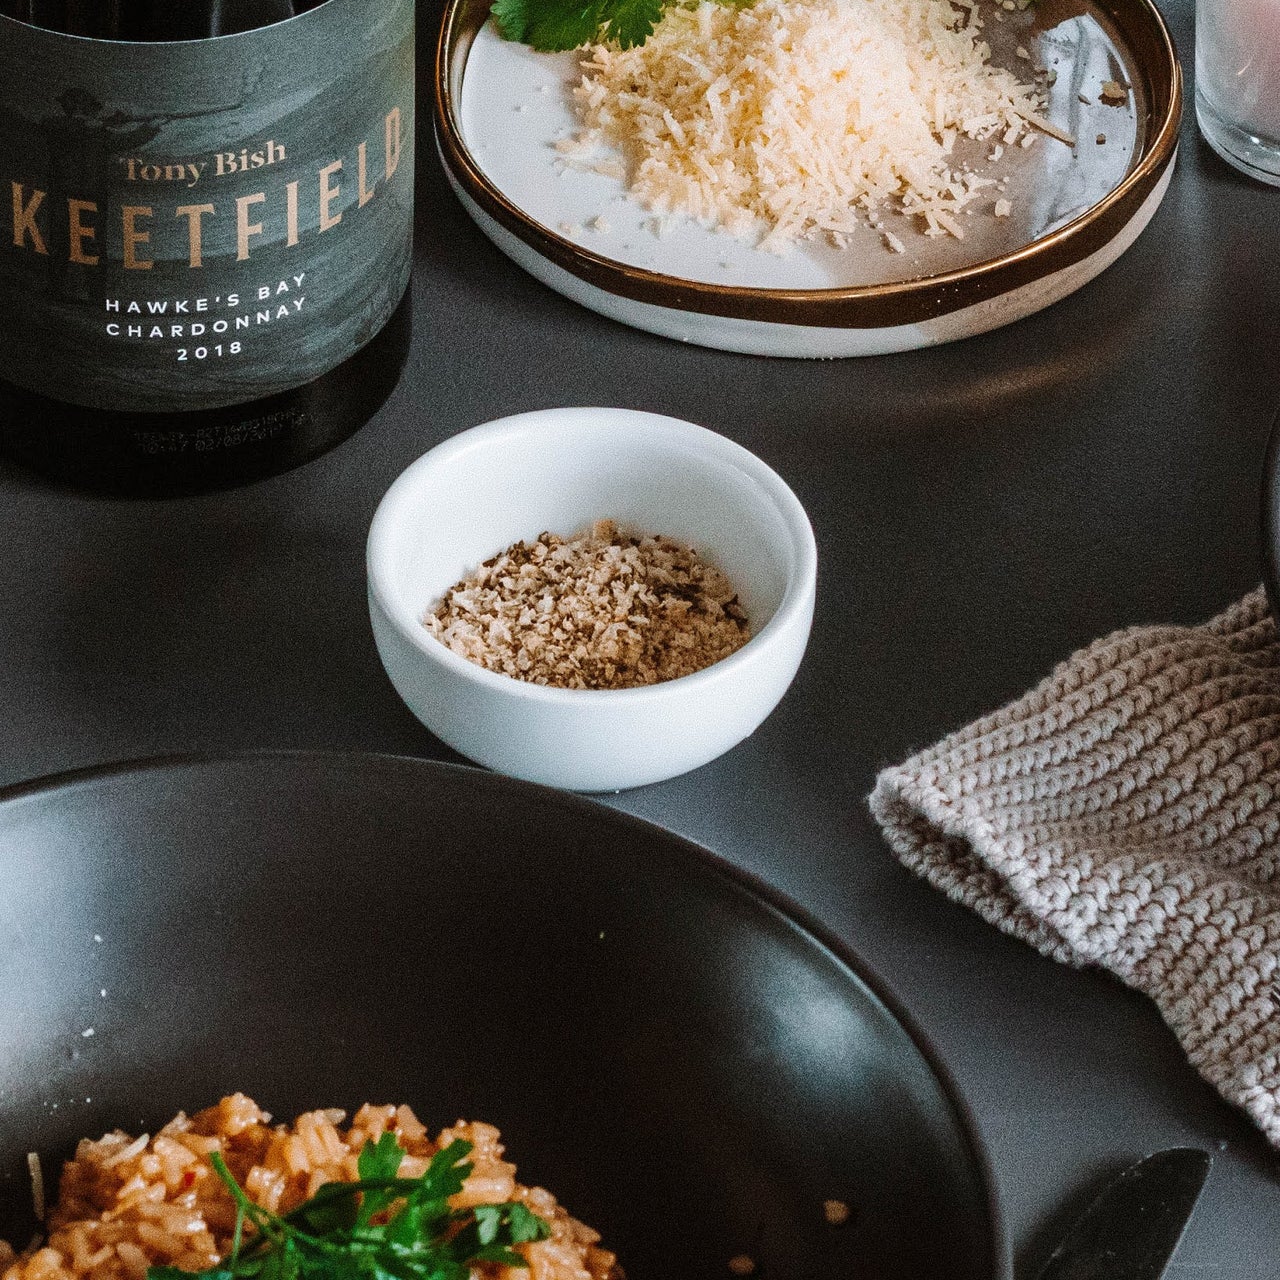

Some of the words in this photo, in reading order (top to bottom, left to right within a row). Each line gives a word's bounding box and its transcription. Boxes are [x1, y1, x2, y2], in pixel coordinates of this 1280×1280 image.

[120, 157, 208, 188] Tony
[214, 140, 287, 177] Bish
[106, 293, 241, 314] HAWKE'S
[257, 272, 306, 301] BAY
[106, 296, 306, 338] CHARDONNAY
[176, 341, 242, 361] 2018
